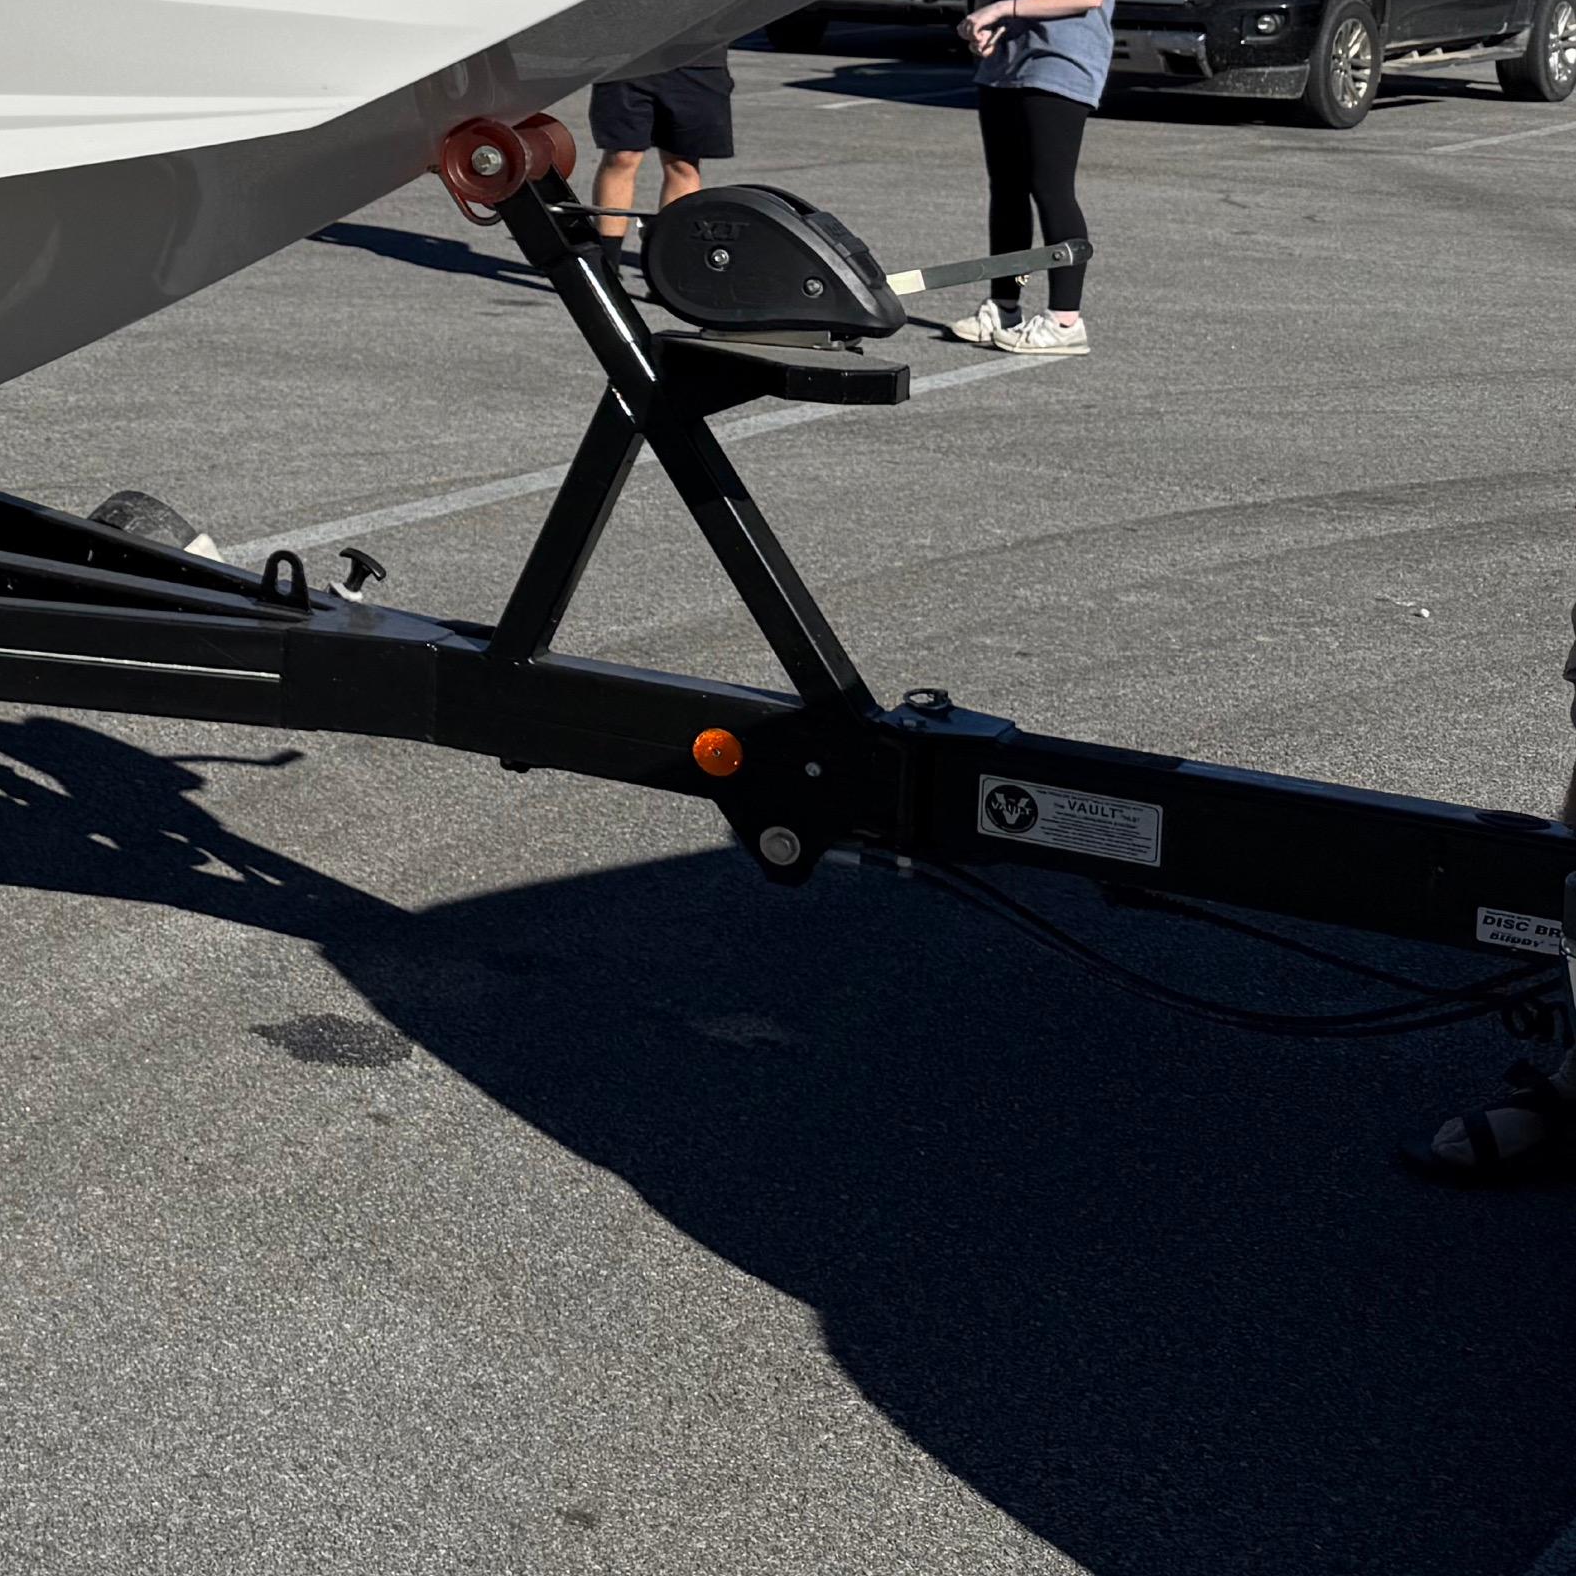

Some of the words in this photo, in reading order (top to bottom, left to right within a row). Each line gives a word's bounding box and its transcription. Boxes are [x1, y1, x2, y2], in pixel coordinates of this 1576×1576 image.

[1067, 800, 1117, 818] VAULT
[1482, 915, 1529, 931] DISC
[1535, 925, 1561, 938] BR
